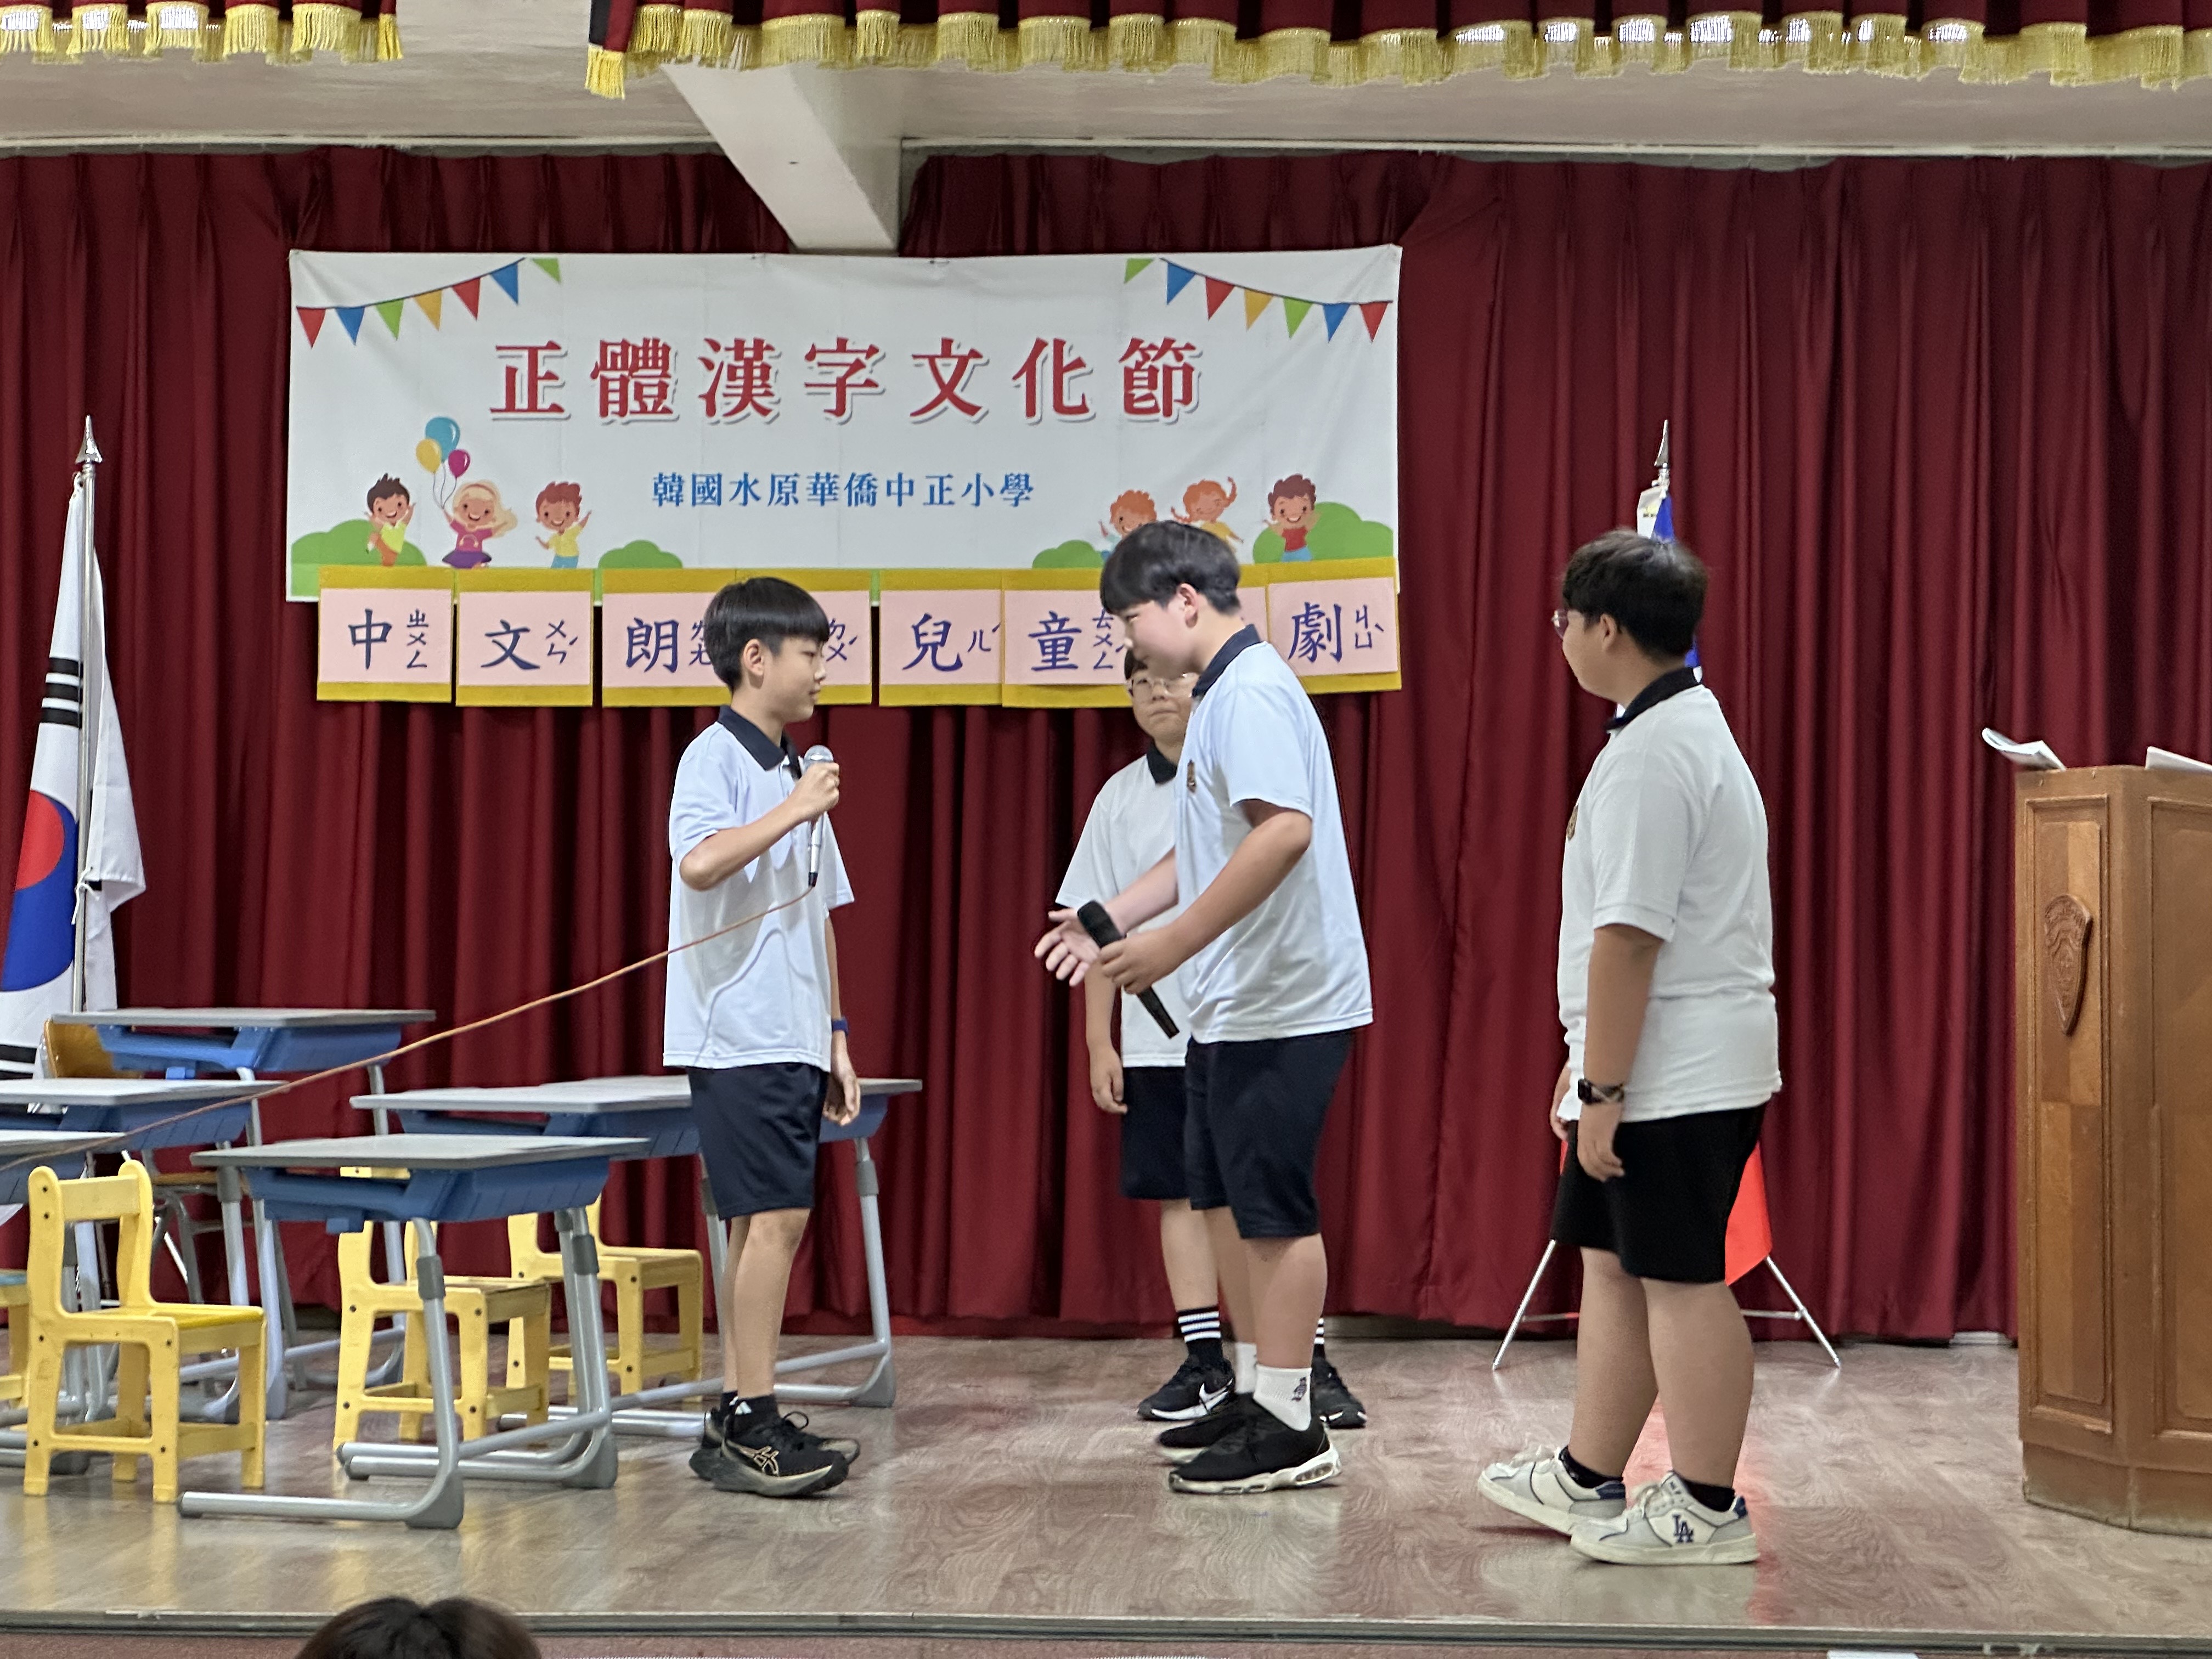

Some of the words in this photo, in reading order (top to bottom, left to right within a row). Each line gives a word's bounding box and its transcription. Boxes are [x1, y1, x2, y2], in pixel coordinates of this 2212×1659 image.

[490, 336, 1198, 420] 正體漢字文化節
[652, 472, 1034, 507] 韓國水原華僑中正小學
[348, 610, 392, 669] 中
[482, 620, 540, 670] 文
[627, 618, 679, 673] 朗
[904, 614, 963, 672] 兒
[1029, 612, 1082, 672] 童
[1289, 602, 1342, 663] 劇
[1672, 1514, 1694, 1544] LA
